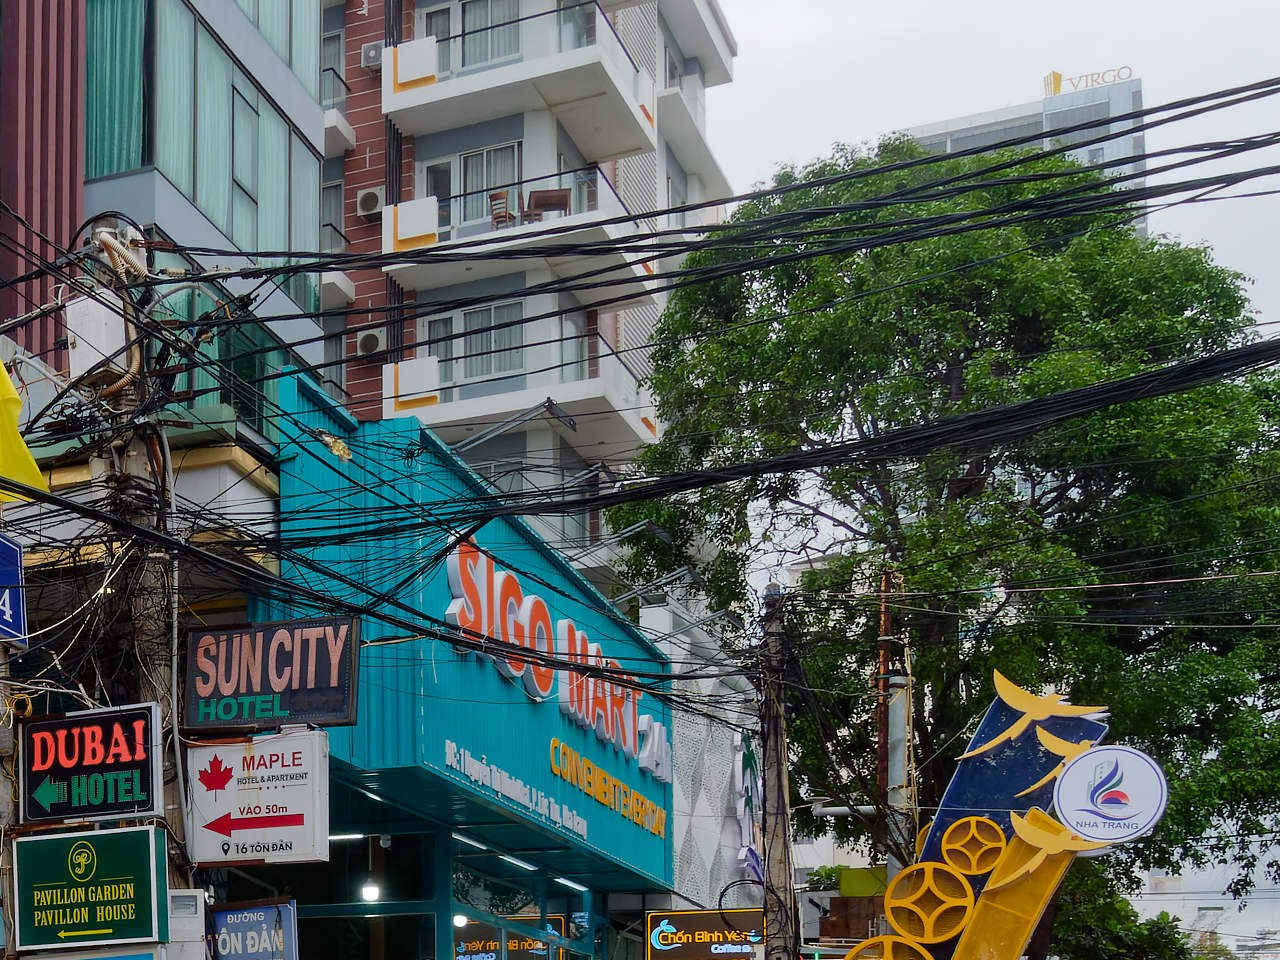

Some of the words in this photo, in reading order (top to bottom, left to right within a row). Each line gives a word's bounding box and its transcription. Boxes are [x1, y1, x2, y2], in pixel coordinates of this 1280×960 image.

[1068, 65, 1133, 90] VIRGO
[195, 631, 265, 698] SUN
[269, 624, 349, 690] CITY
[197, 694, 291, 723] HOTEL
[31, 719, 147, 772] DUBAI
[241, 751, 303, 772] MAPLE
[72, 769, 147, 807] HOTEL
[237, 777, 260, 785] HOTEL
[266, 772, 308, 783] APARTMENT
[238, 804, 262, 815] VÀO
[265, 804, 288, 814] 50m
[1075, 821, 1098, 829] NHA
[1102, 821, 1139, 830] TRANG
[235, 844, 248, 854] 16
[33, 887, 86, 907] PAVILLON
[88, 883, 135, 902] GARDEN
[34, 907, 90, 927] PAVILLON
[96, 903, 136, 922] HOUSE
[227, 911, 265, 924] ĐƯỜNG
[660, 930, 692, 944] Chốn
